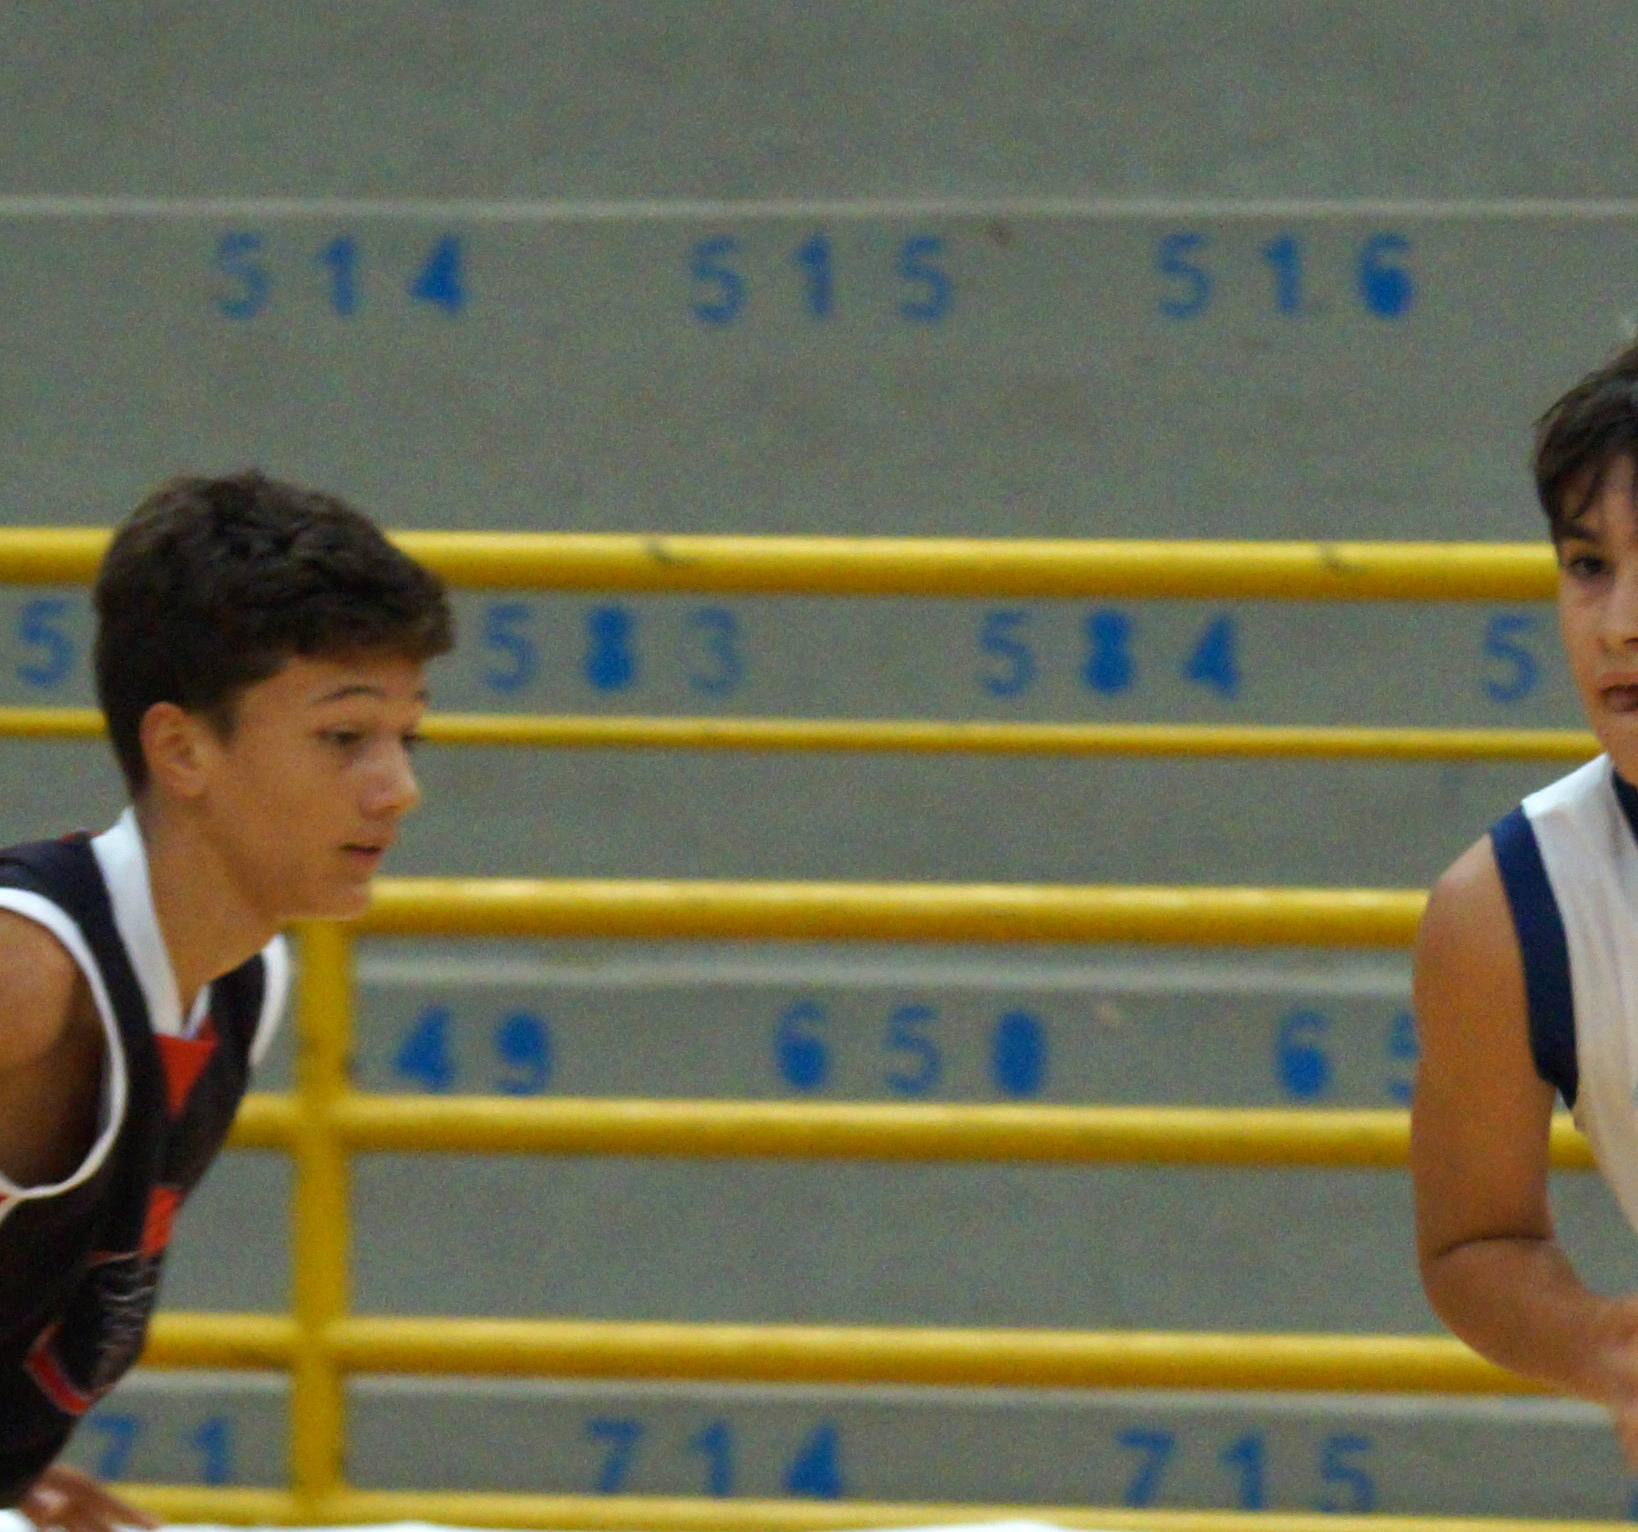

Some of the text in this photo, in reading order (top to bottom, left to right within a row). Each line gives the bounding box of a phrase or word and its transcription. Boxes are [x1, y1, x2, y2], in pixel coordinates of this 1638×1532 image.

[217, 229, 474, 323] 514
[688, 233, 955, 327] 515
[1154, 229, 1420, 325] 516
[481, 602, 745, 699] 583
[976, 605, 1245, 703] 584
[767, 997, 1054, 1101] 650
[583, 1415, 850, 1501] 714
